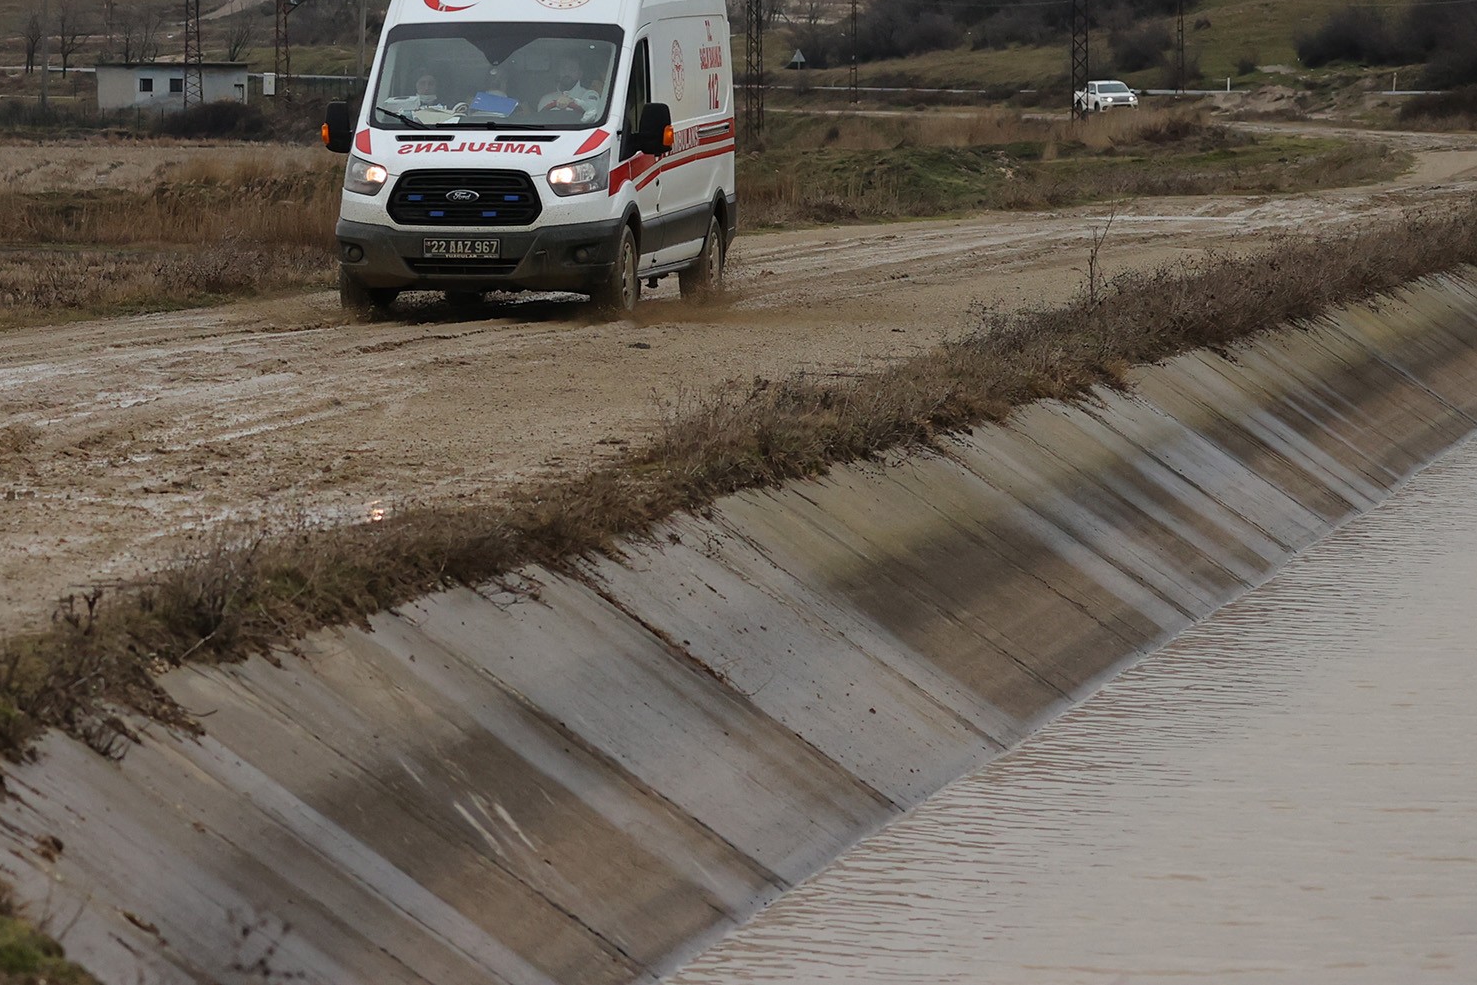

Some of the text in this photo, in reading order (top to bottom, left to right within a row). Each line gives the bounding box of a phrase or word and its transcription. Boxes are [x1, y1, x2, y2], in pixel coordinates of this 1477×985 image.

[707, 73, 719, 110] 112
[452, 191, 472, 200] Ford
[431, 240, 498, 253] 22 AAZ 967
